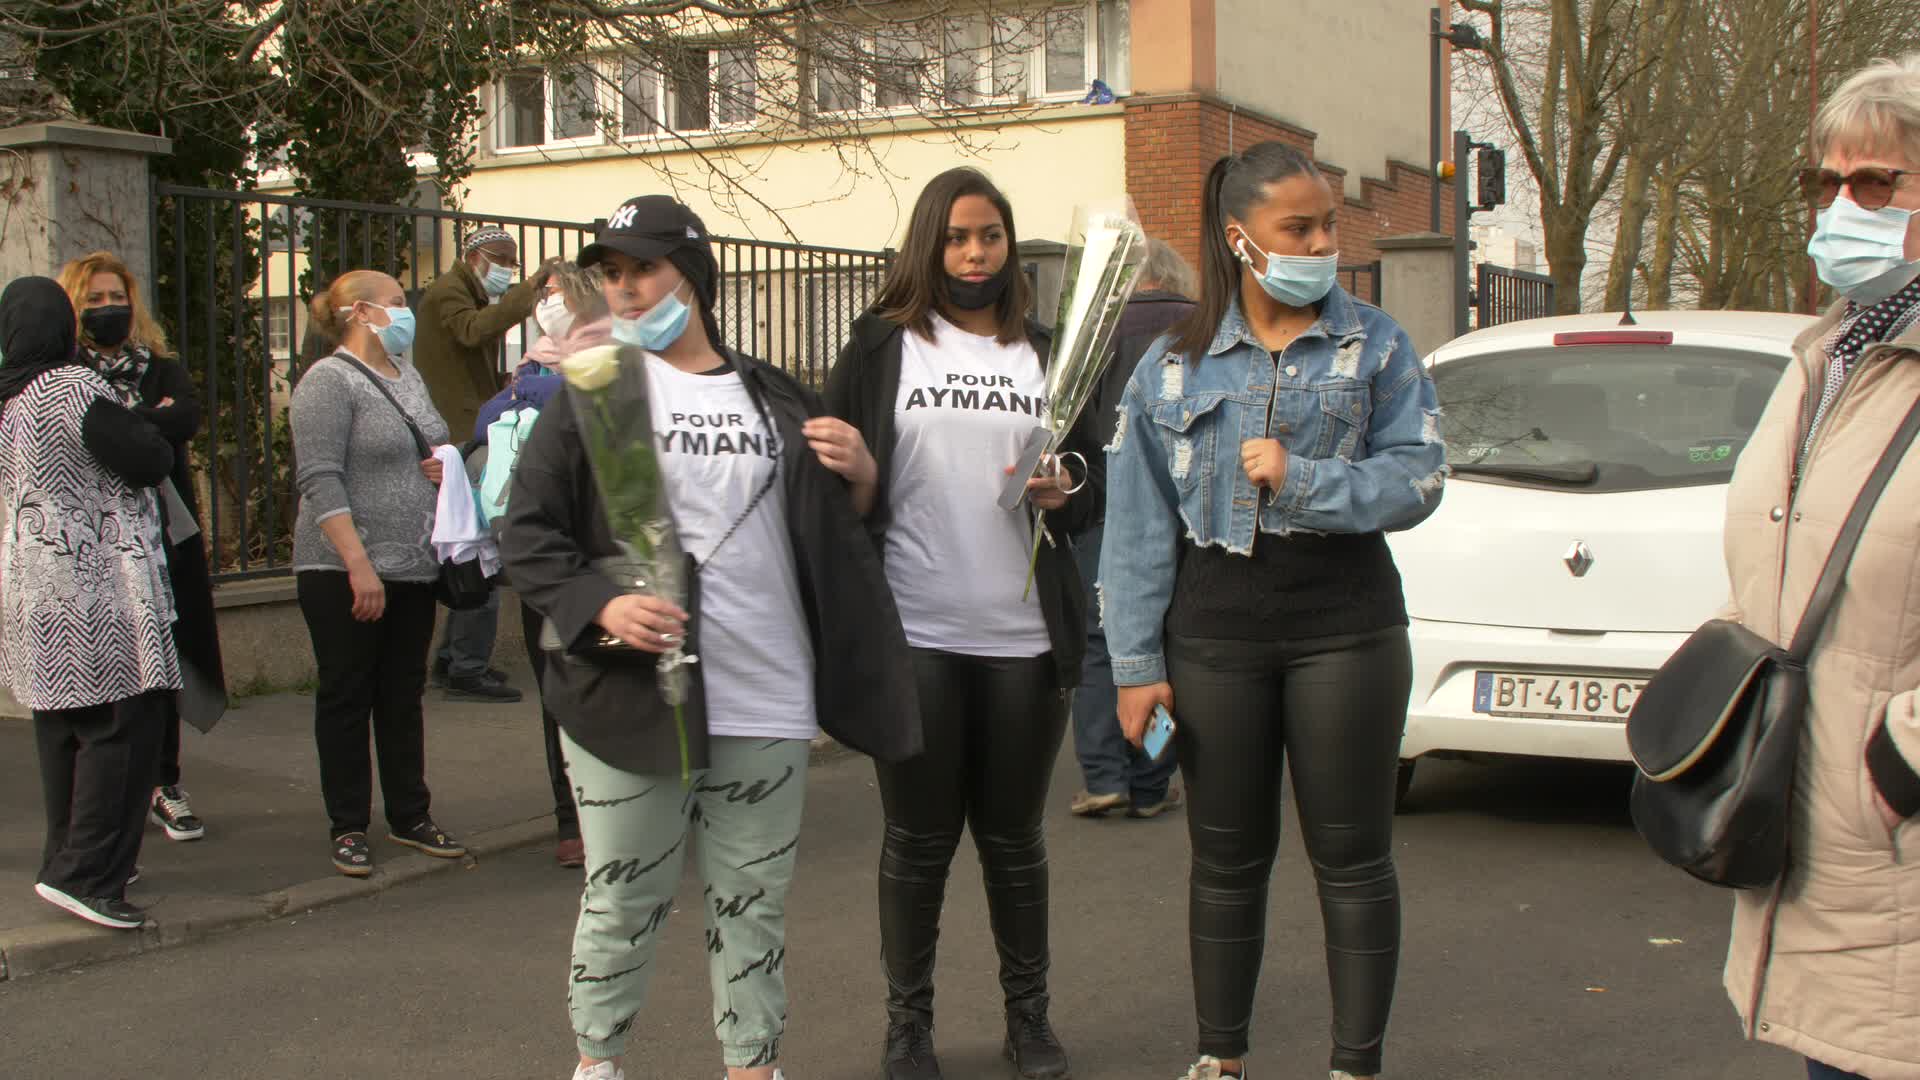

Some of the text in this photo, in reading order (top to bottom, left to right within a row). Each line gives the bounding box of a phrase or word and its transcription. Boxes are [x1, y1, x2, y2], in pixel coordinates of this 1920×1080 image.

[608, 204, 638, 229] NY
[946, 373, 1015, 388] POUR
[671, 412, 745, 428] POUR
[656, 429, 778, 460] YMANE
